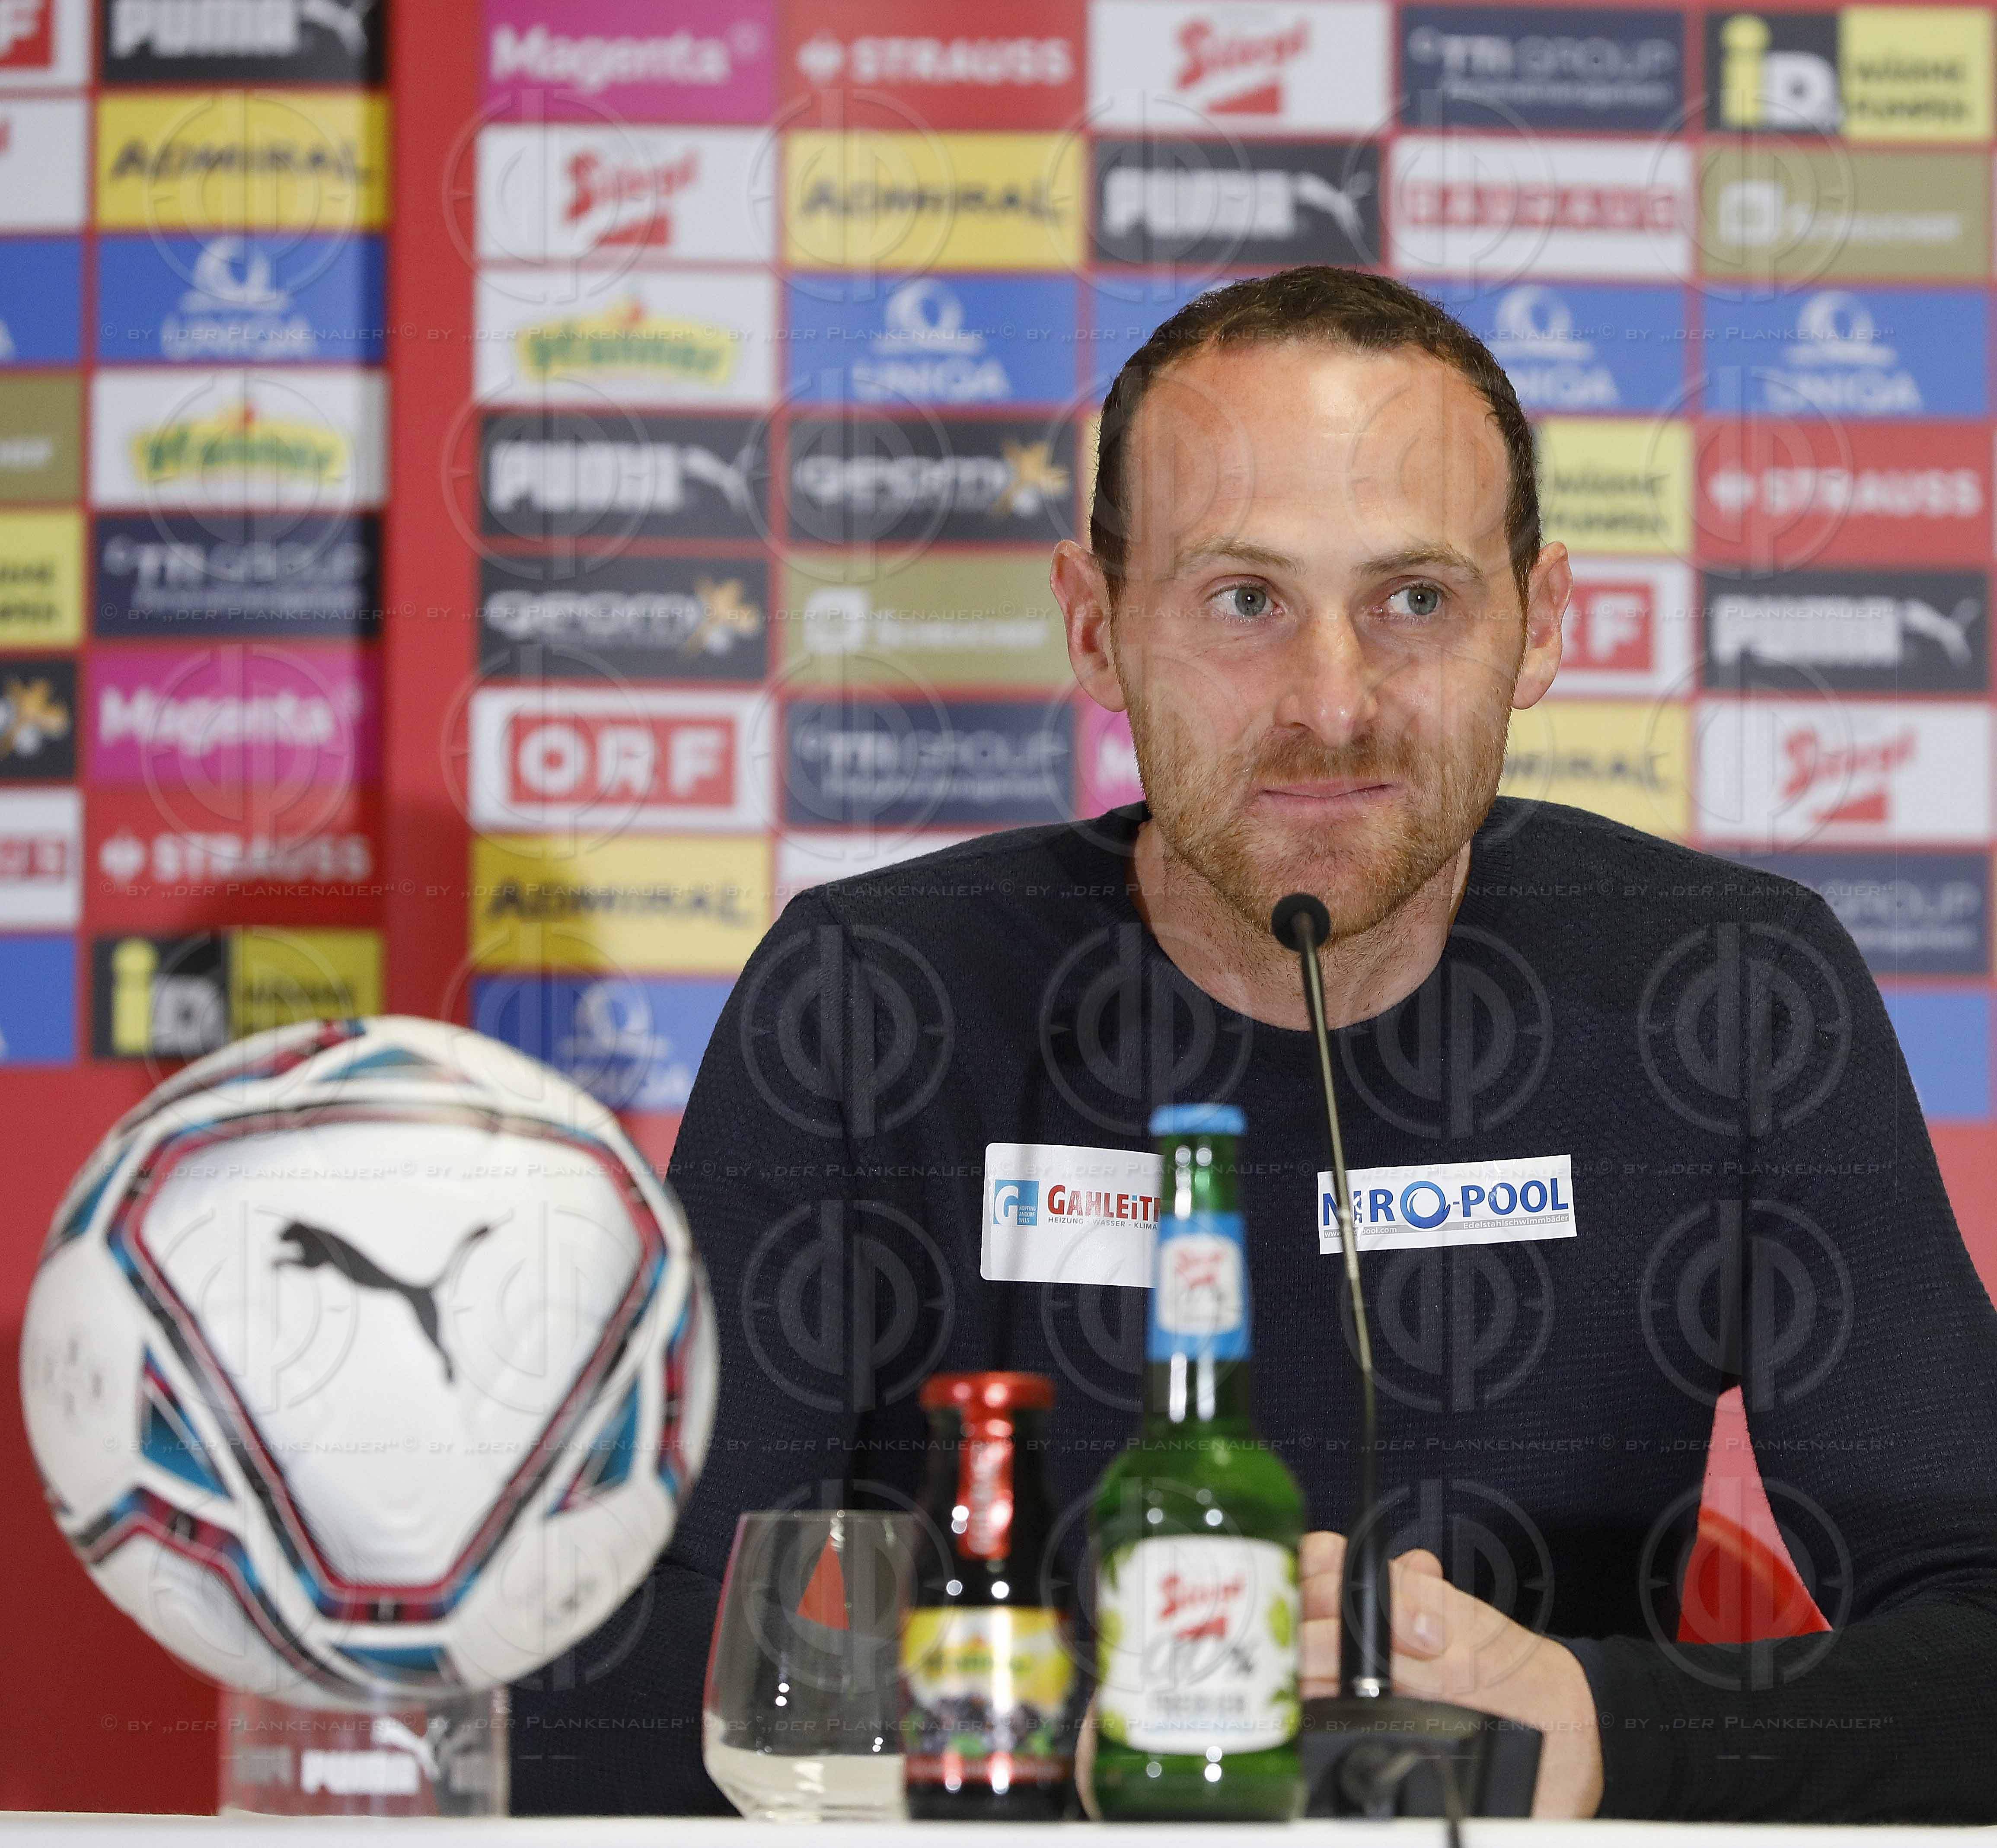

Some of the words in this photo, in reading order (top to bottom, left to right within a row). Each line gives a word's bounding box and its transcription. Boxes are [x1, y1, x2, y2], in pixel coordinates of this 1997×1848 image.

[492, 26, 731, 90] Magenta
[852, 39, 1073, 82] STRAUSS
[109, 142, 374, 182] ADMIRAL
[802, 179, 1068, 220] ADMIRAL
[1107, 172, 1293, 236] PUMA
[854, 361, 1011, 400] UNIQA
[1766, 372, 1924, 409] UNIQA
[493, 445, 679, 509] PUMA
[1761, 472, 1980, 514] STRAUSS
[1714, 597, 1898, 664] PUMA
[99, 686, 334, 751] Magenta
[521, 727, 724, 796] ORF
[152, 835, 373, 882] STRAUSS
[488, 877, 750, 927] ADMIRAL
[1463, 1214, 1569, 1229] Edelstahlschwimmbäder
